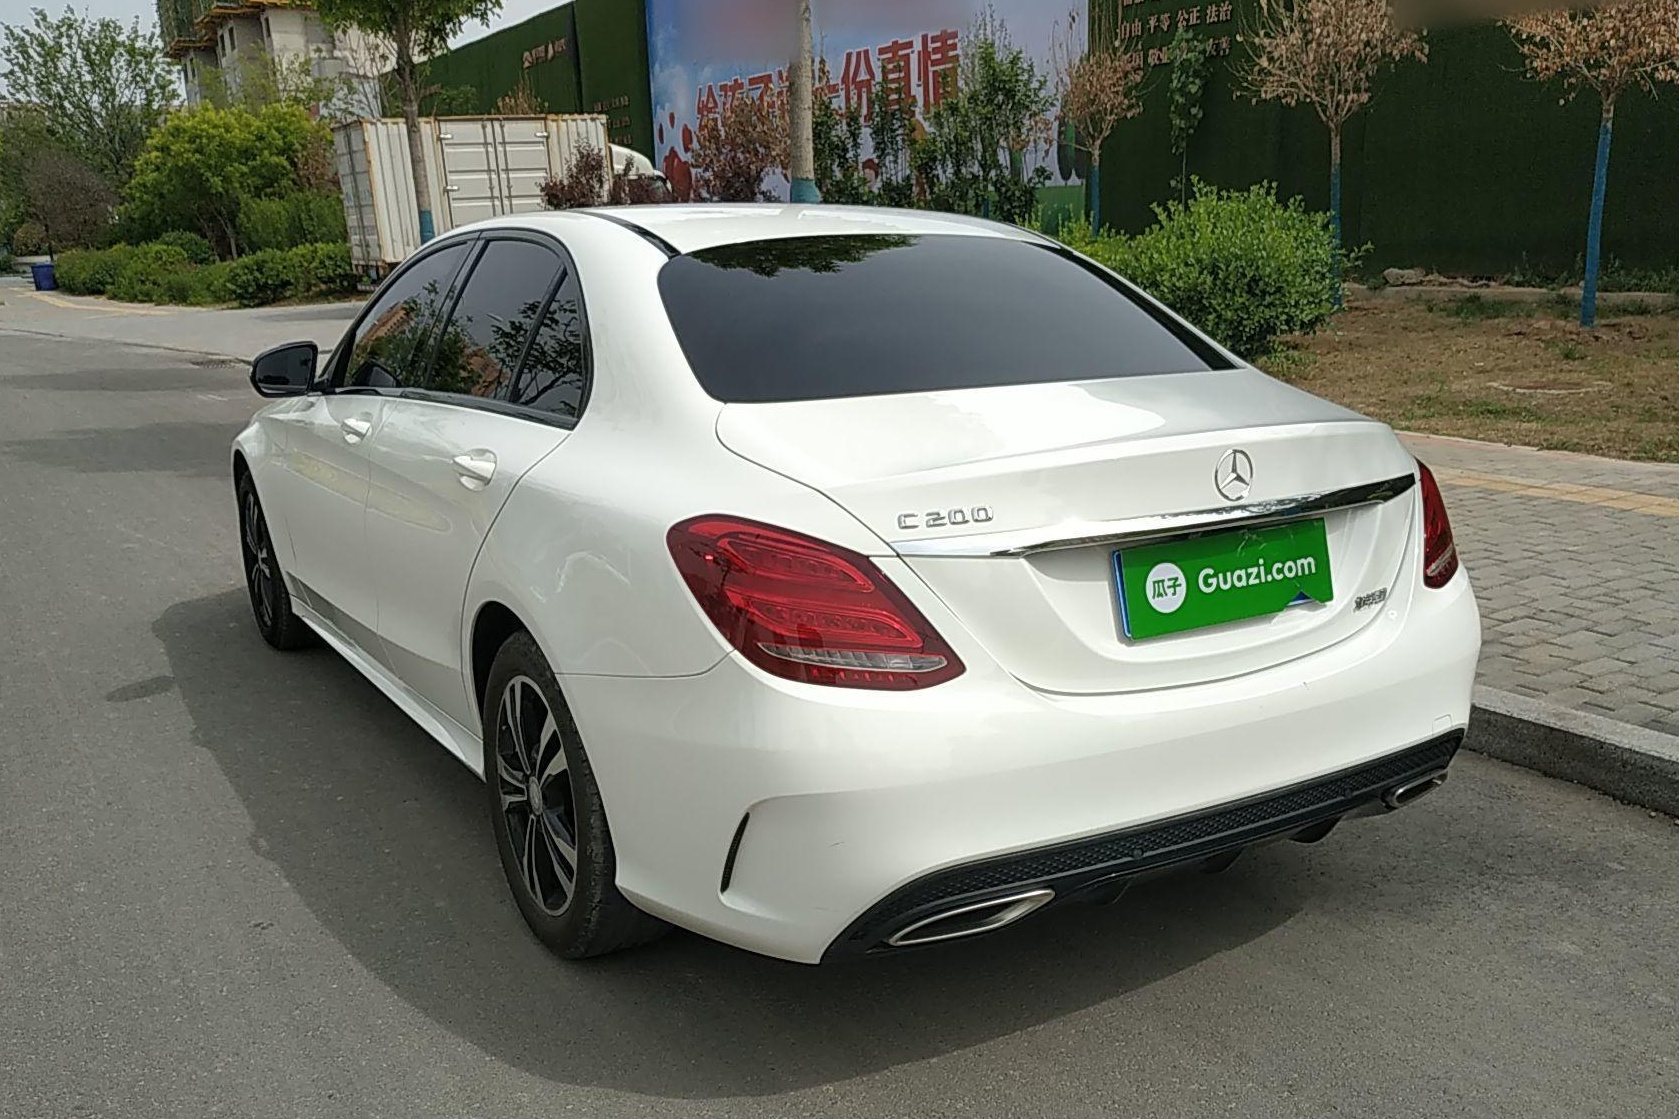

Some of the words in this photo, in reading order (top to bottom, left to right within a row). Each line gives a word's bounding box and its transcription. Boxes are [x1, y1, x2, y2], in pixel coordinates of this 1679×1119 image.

[1121, 18, 1142, 39] 自由
[1147, 12, 1171, 34] 平等
[1176, 5, 1201, 27] 公正
[1206, 1, 1232, 24] 法治
[1206, 36, 1231, 57] 友善
[897, 513, 919, 529] C
[925, 506, 994, 528] 200
[1198, 556, 1316, 594] Guazi.com
[1152, 576, 1182, 600] 瓜子
